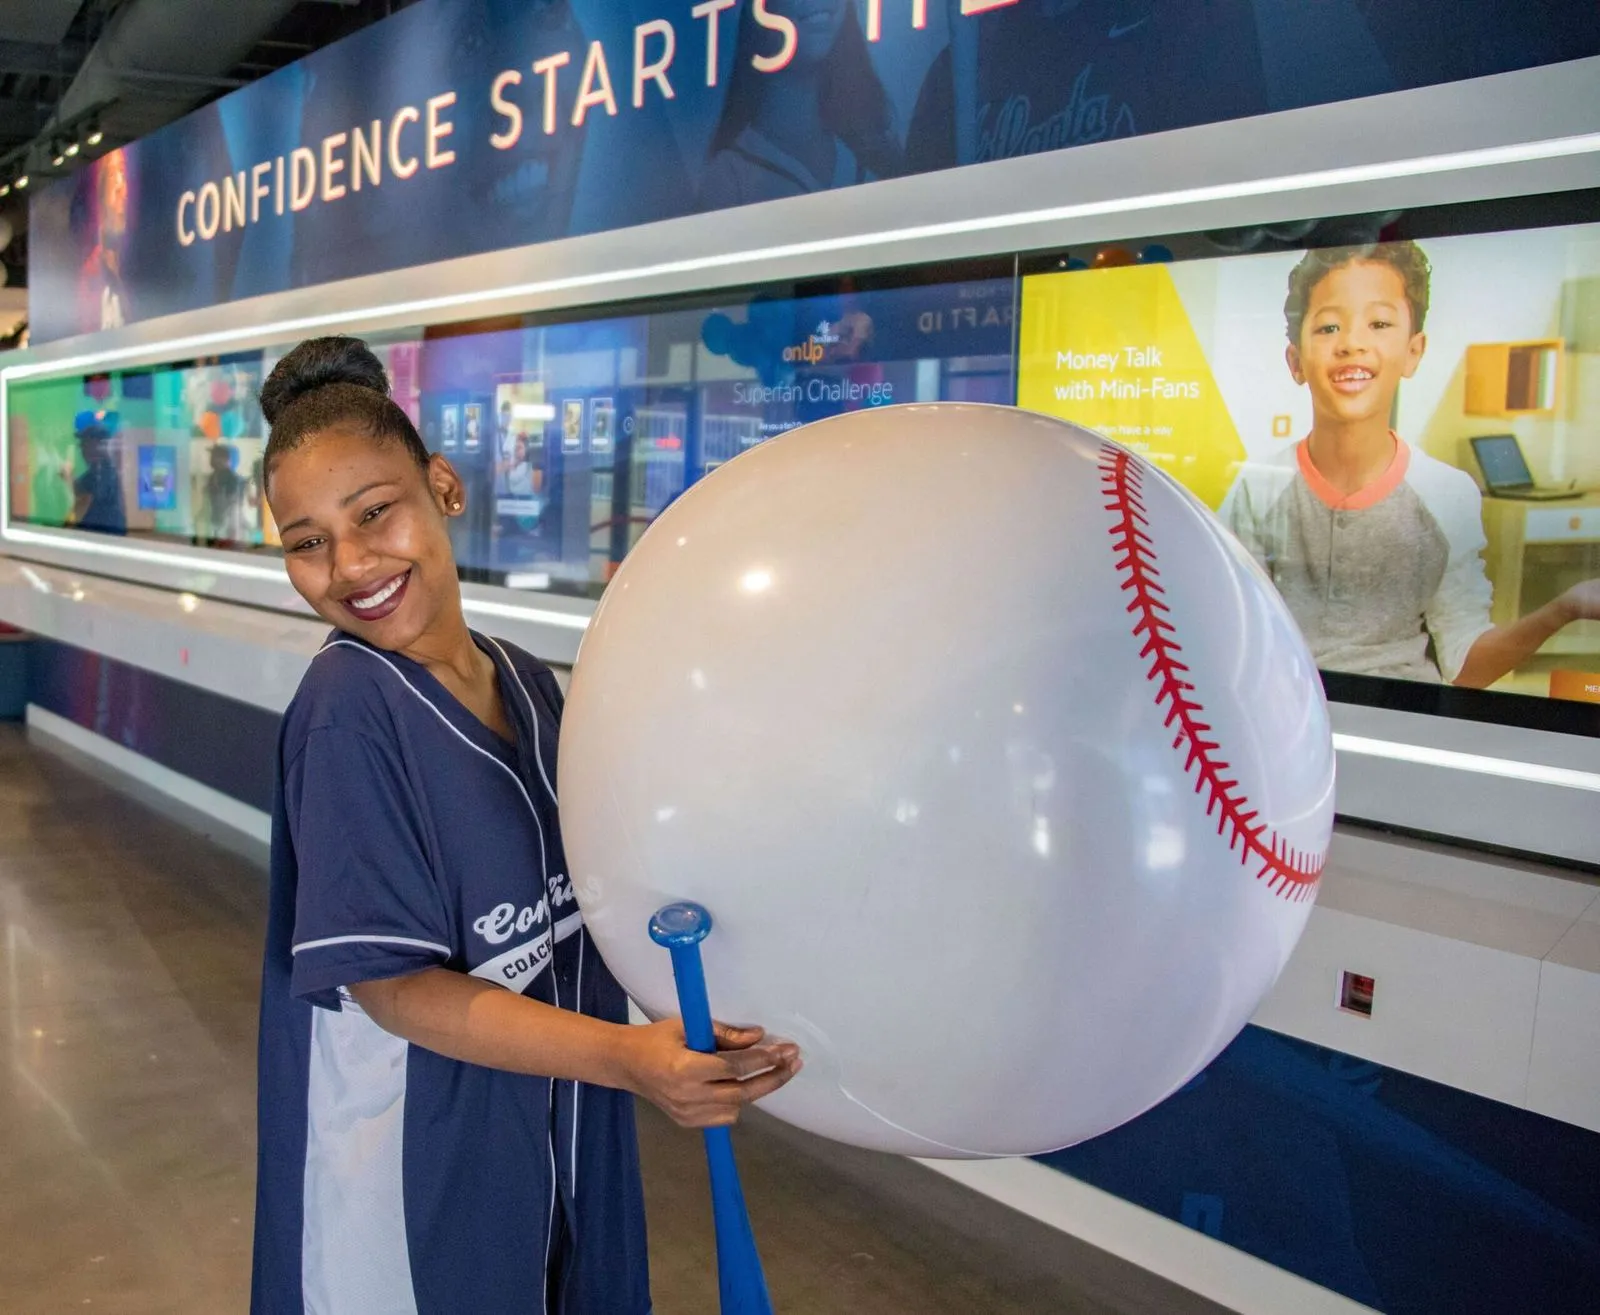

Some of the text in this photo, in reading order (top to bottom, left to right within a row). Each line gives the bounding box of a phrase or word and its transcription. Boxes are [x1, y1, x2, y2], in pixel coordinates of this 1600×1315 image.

[176, 0, 798, 248] CONFIDENCE STARTS
[1056, 345, 1162, 373] Money Talk
[733, 377, 894, 407] Superfan Challenge
[1055, 376, 1200, 401] with Mini-Fans
